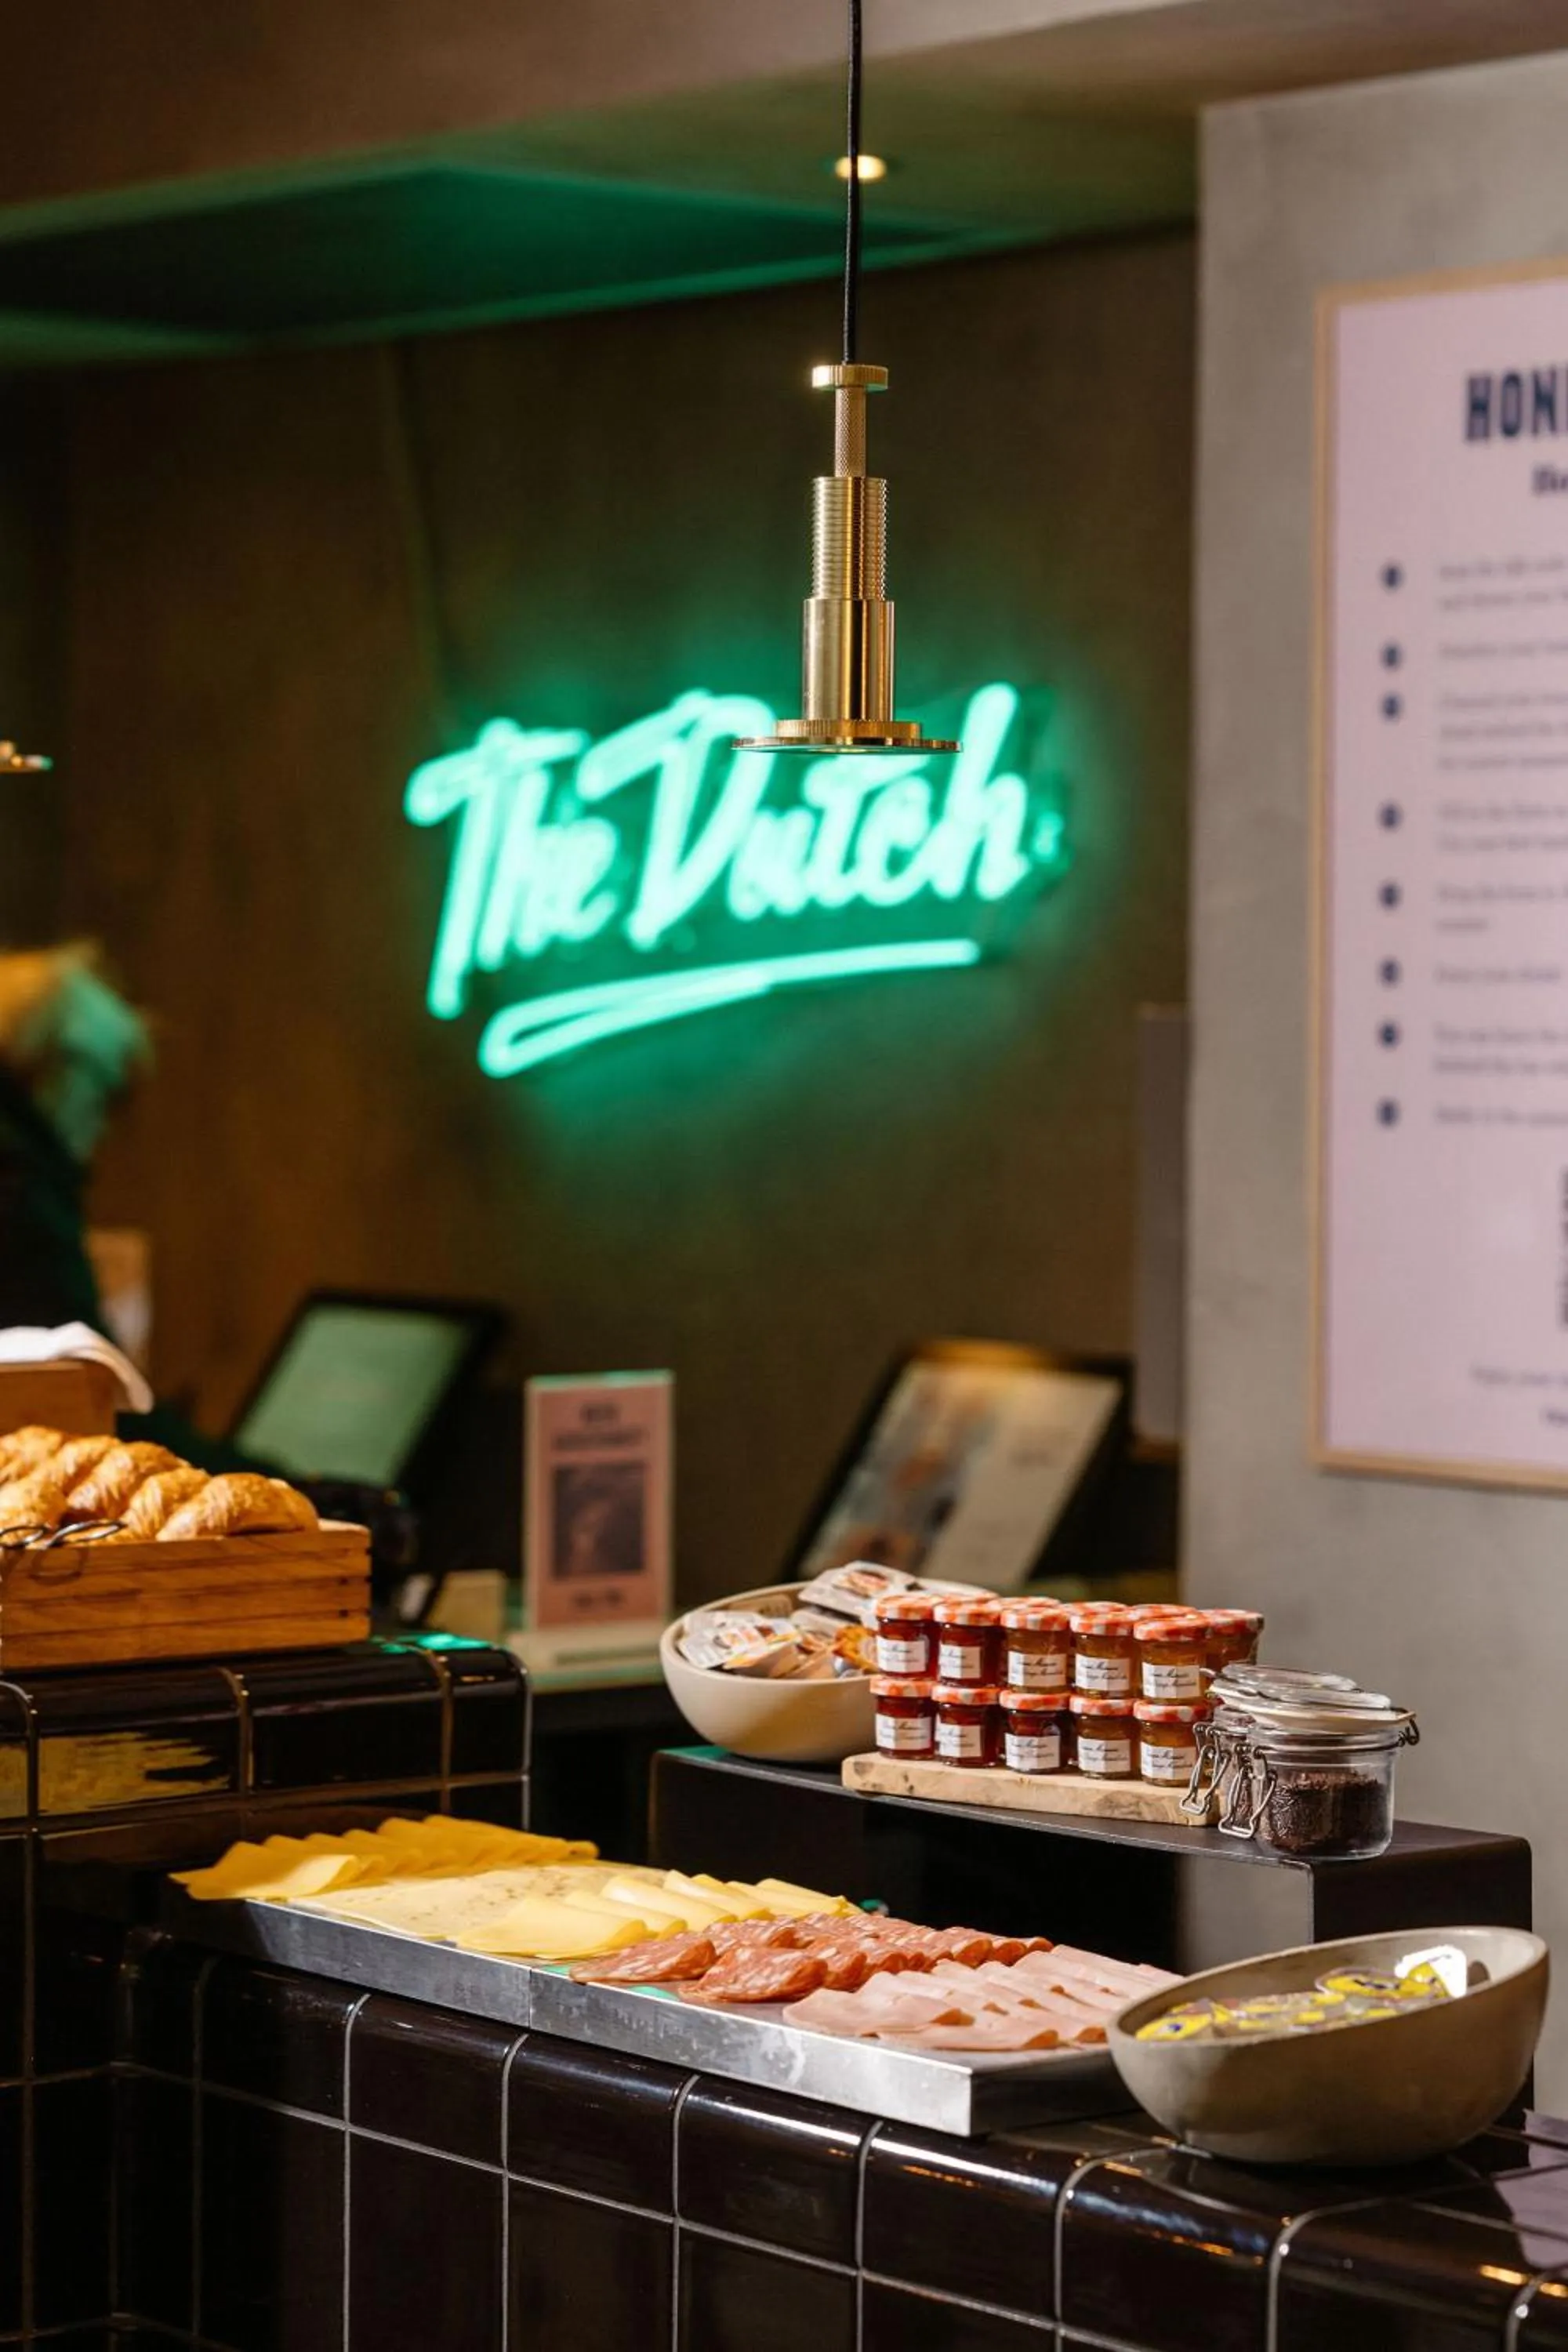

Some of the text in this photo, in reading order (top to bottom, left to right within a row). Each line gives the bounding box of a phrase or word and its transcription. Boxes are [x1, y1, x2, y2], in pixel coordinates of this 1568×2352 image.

[1465, 366, 1568, 442] HON
[405, 682, 1032, 1019] The Dutch
